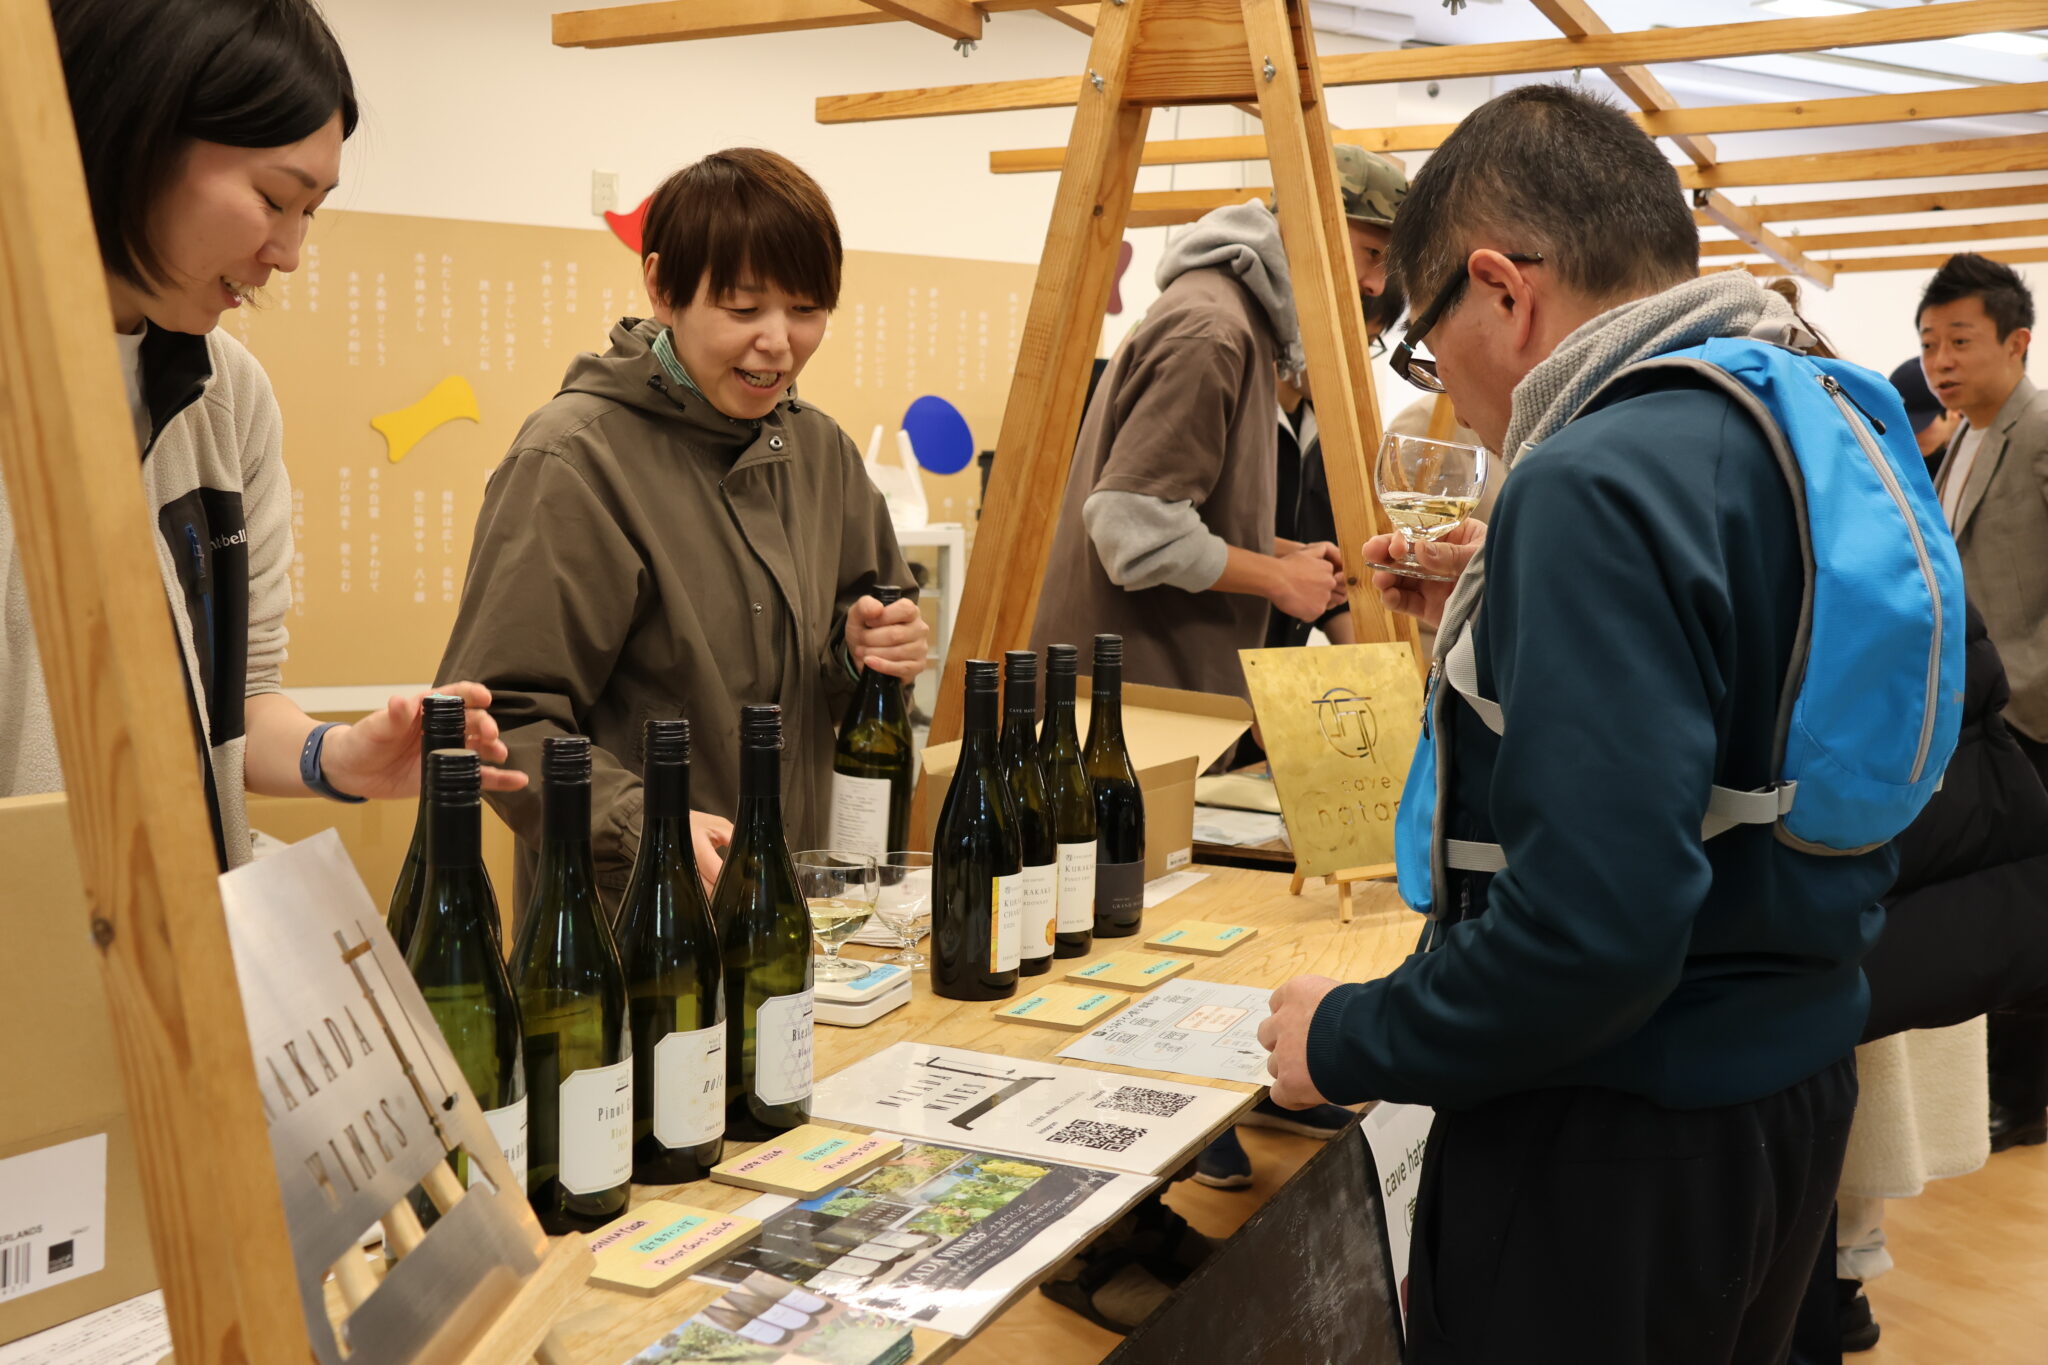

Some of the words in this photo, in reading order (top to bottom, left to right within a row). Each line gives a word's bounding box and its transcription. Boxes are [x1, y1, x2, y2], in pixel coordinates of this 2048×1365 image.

[264, 1005, 374, 1123] AKADA
[875, 1072, 953, 1109] NAKADA
[923, 1083, 988, 1112] WINES
[598, 1104, 625, 1122] Pinot
[1385, 1162, 1407, 1198] cave
[942, 1231, 988, 1262] WINES
